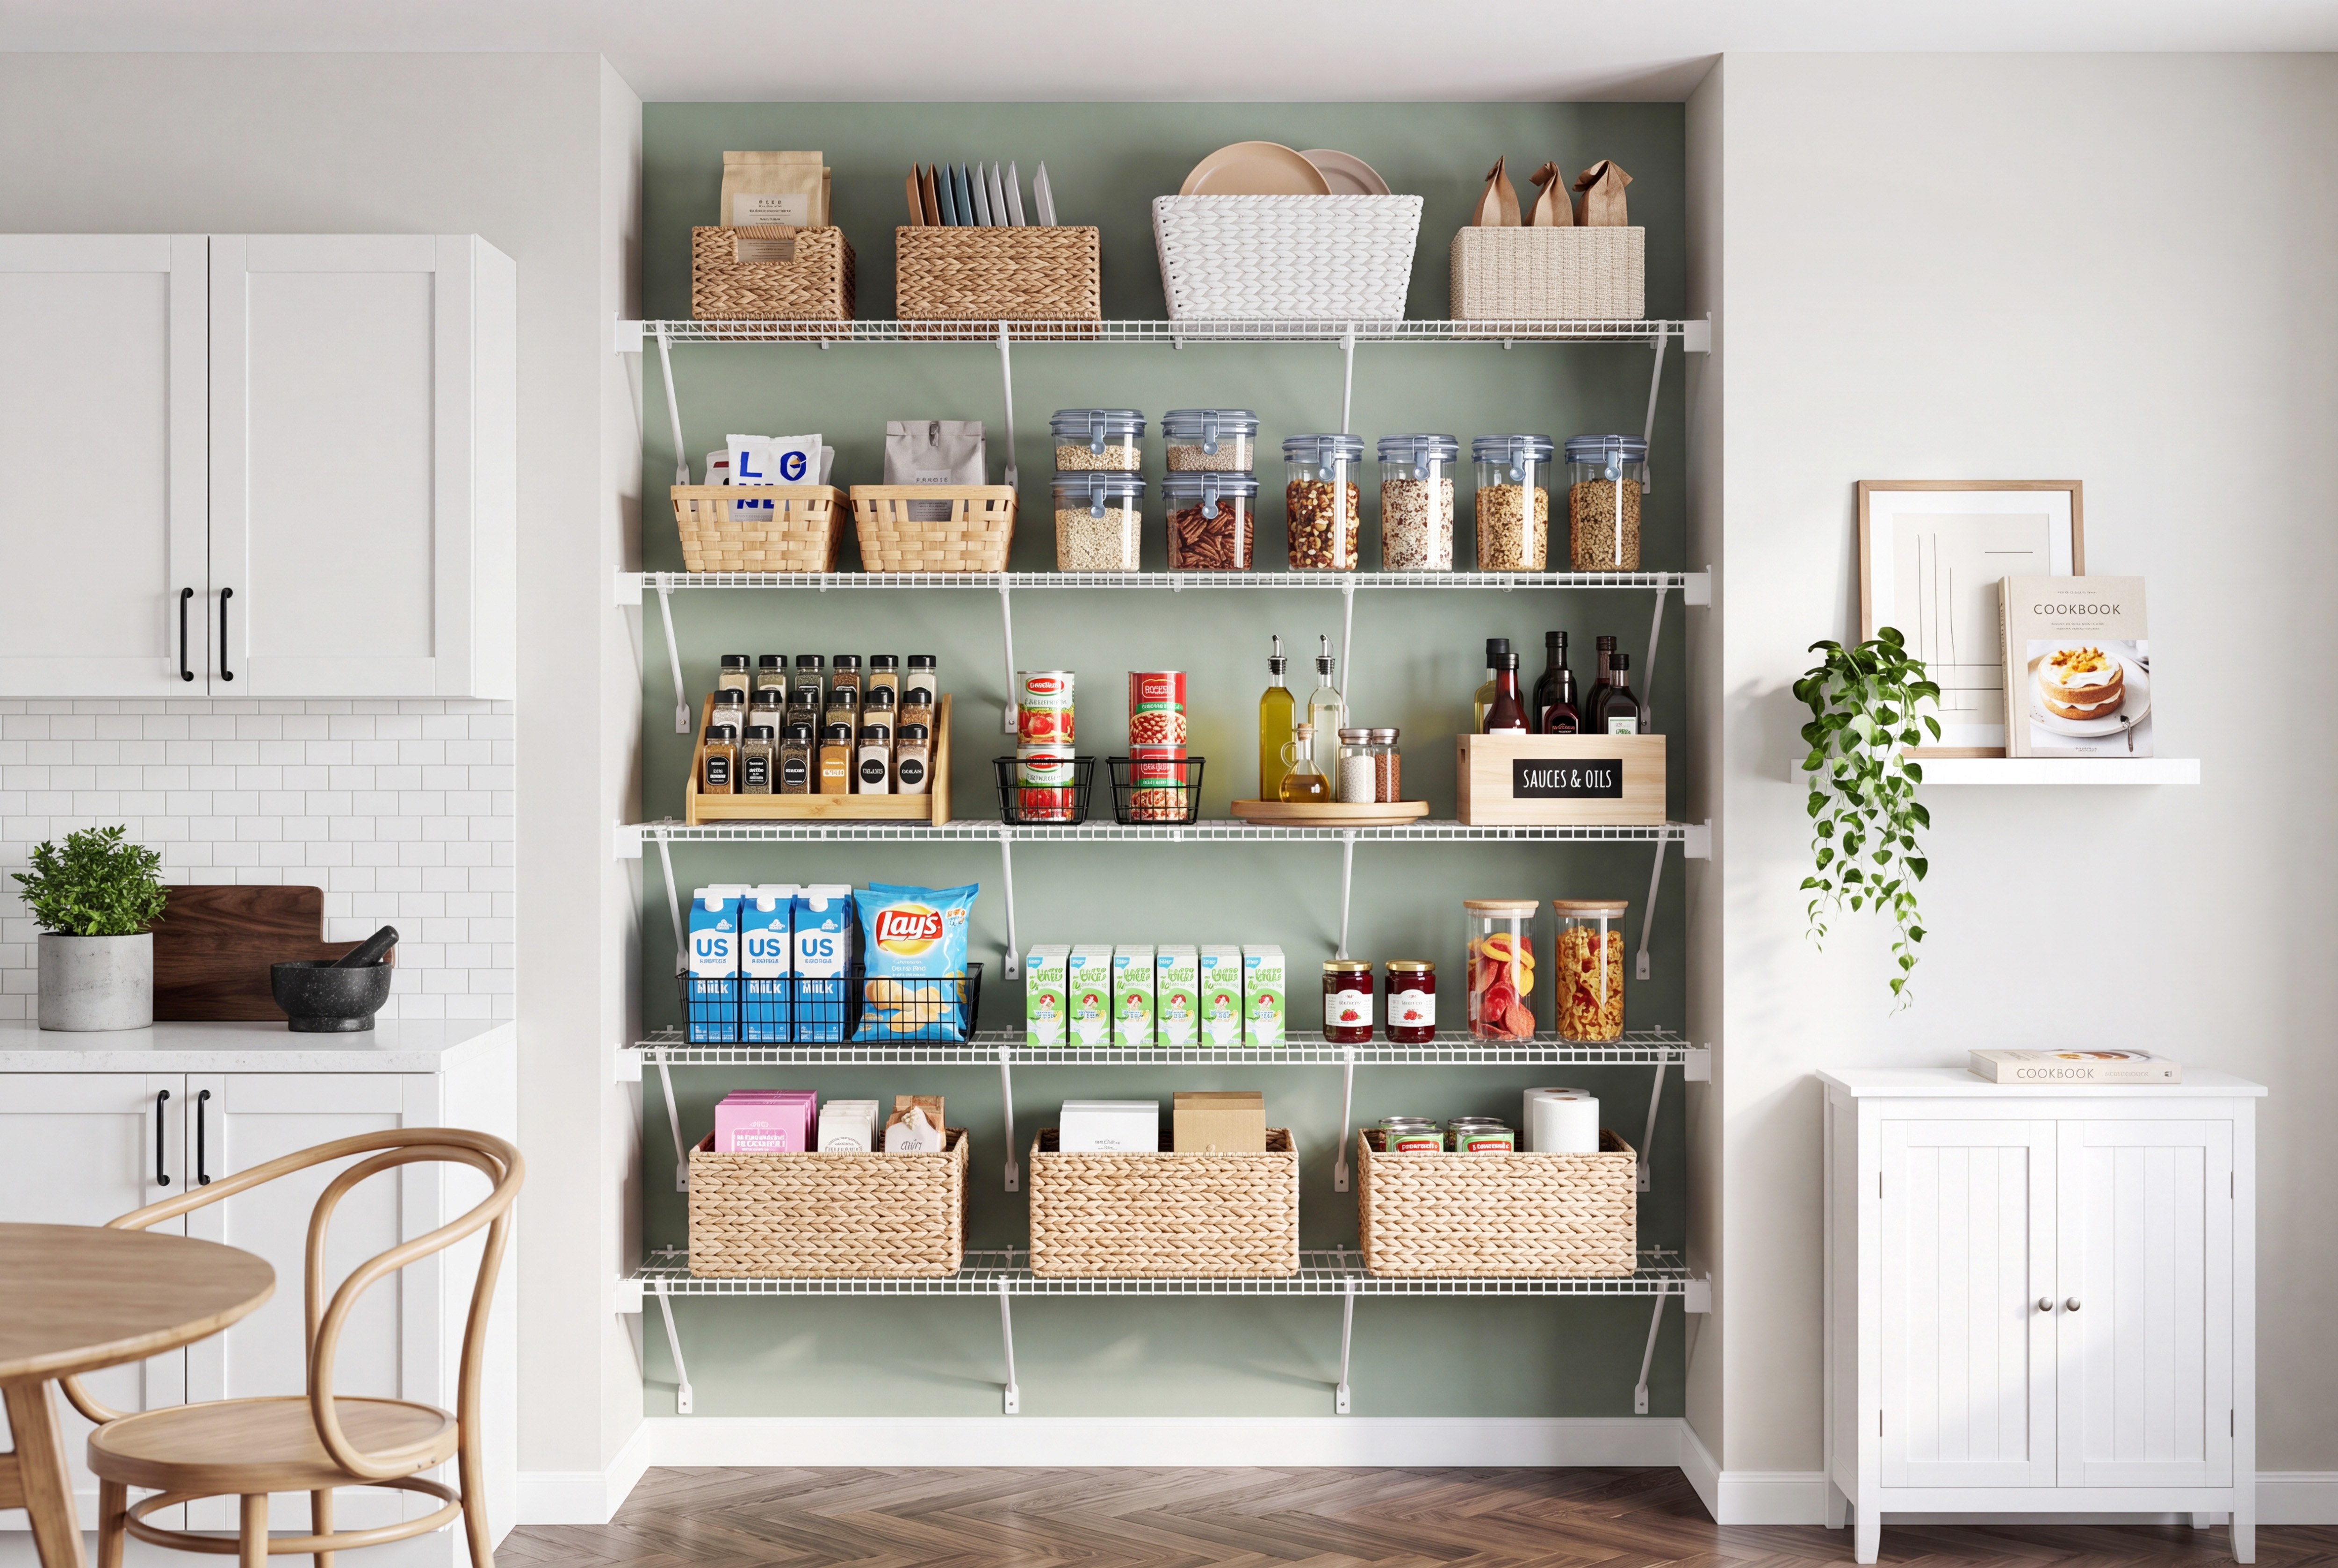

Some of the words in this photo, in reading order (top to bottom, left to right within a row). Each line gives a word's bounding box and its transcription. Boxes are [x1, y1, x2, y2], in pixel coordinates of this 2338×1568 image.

[2034, 604, 2121, 615] COOKBOOK
[1523, 769, 1566, 788] SAUCES
[1570, 769, 1581, 788] &
[1585, 770, 1612, 788] OILS
[879, 911, 938, 941] Lay's
[696, 938, 729, 957] US
[749, 938, 781, 957] US
[801, 938, 834, 957] US
[2017, 1068, 2095, 1079] COOKBOOK
